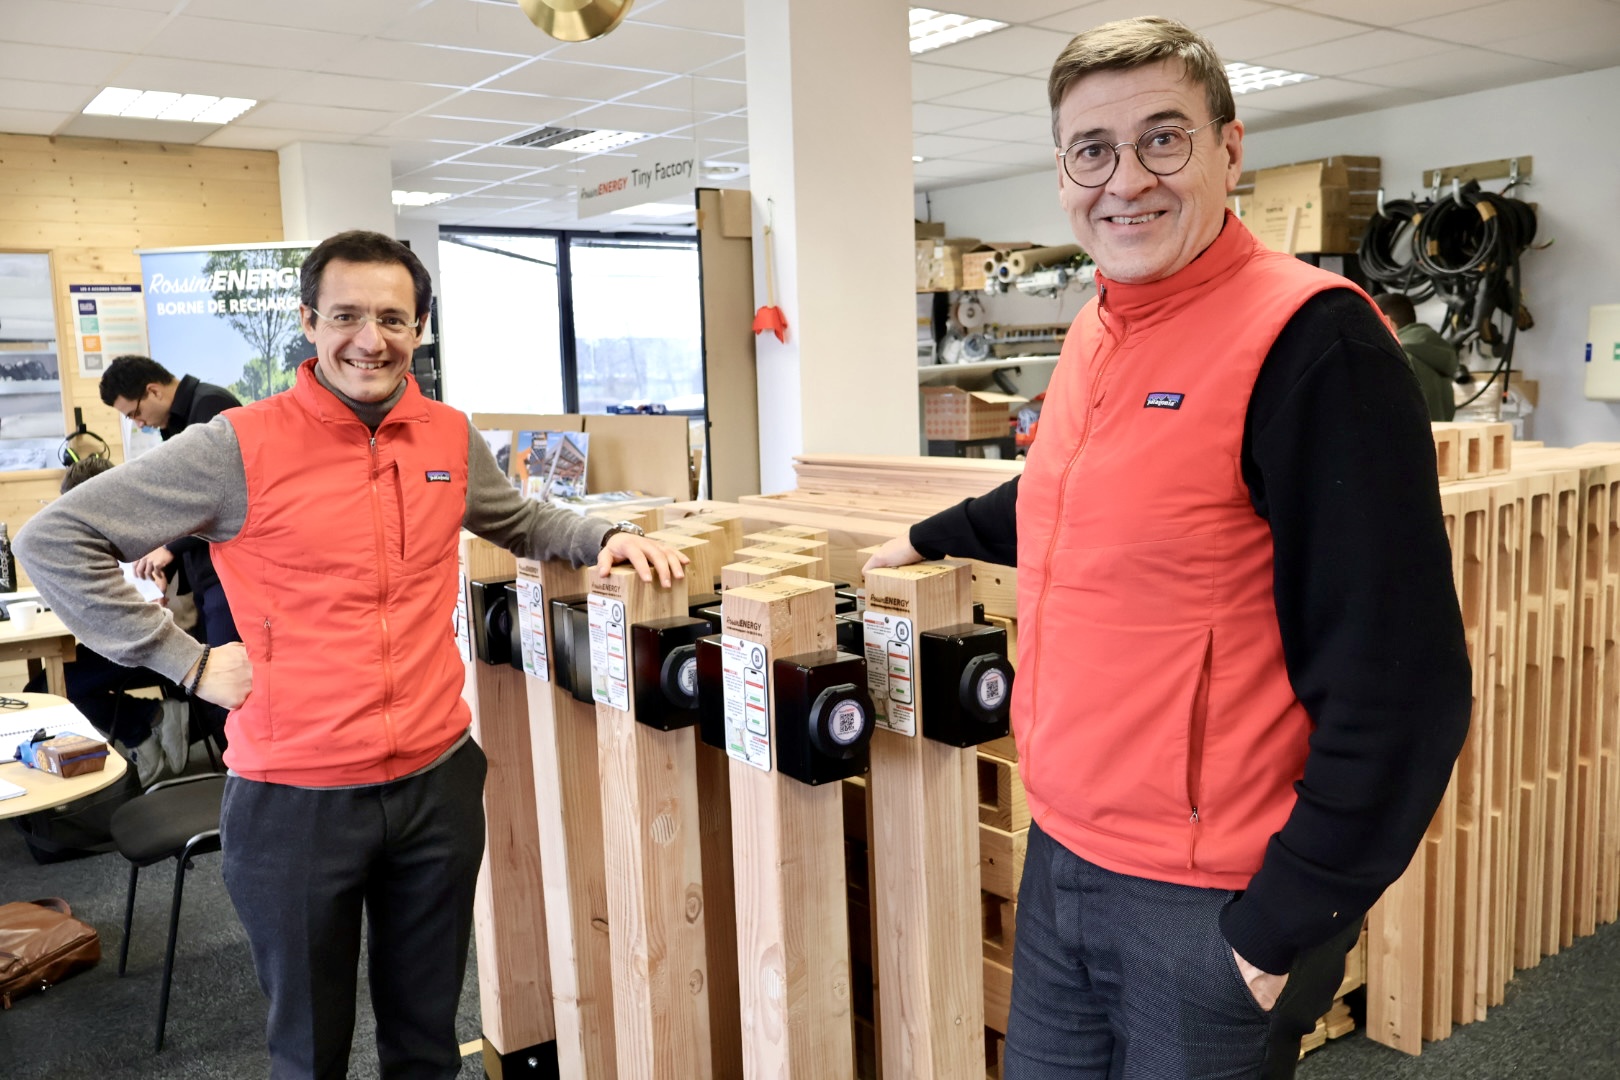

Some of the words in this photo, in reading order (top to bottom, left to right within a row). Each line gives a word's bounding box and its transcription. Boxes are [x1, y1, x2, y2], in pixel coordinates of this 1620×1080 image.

[631, 169, 653, 189] Tiny
[655, 159, 694, 181] Factory
[157, 300, 204, 316] BORNE
[208, 299, 226, 314] DE
